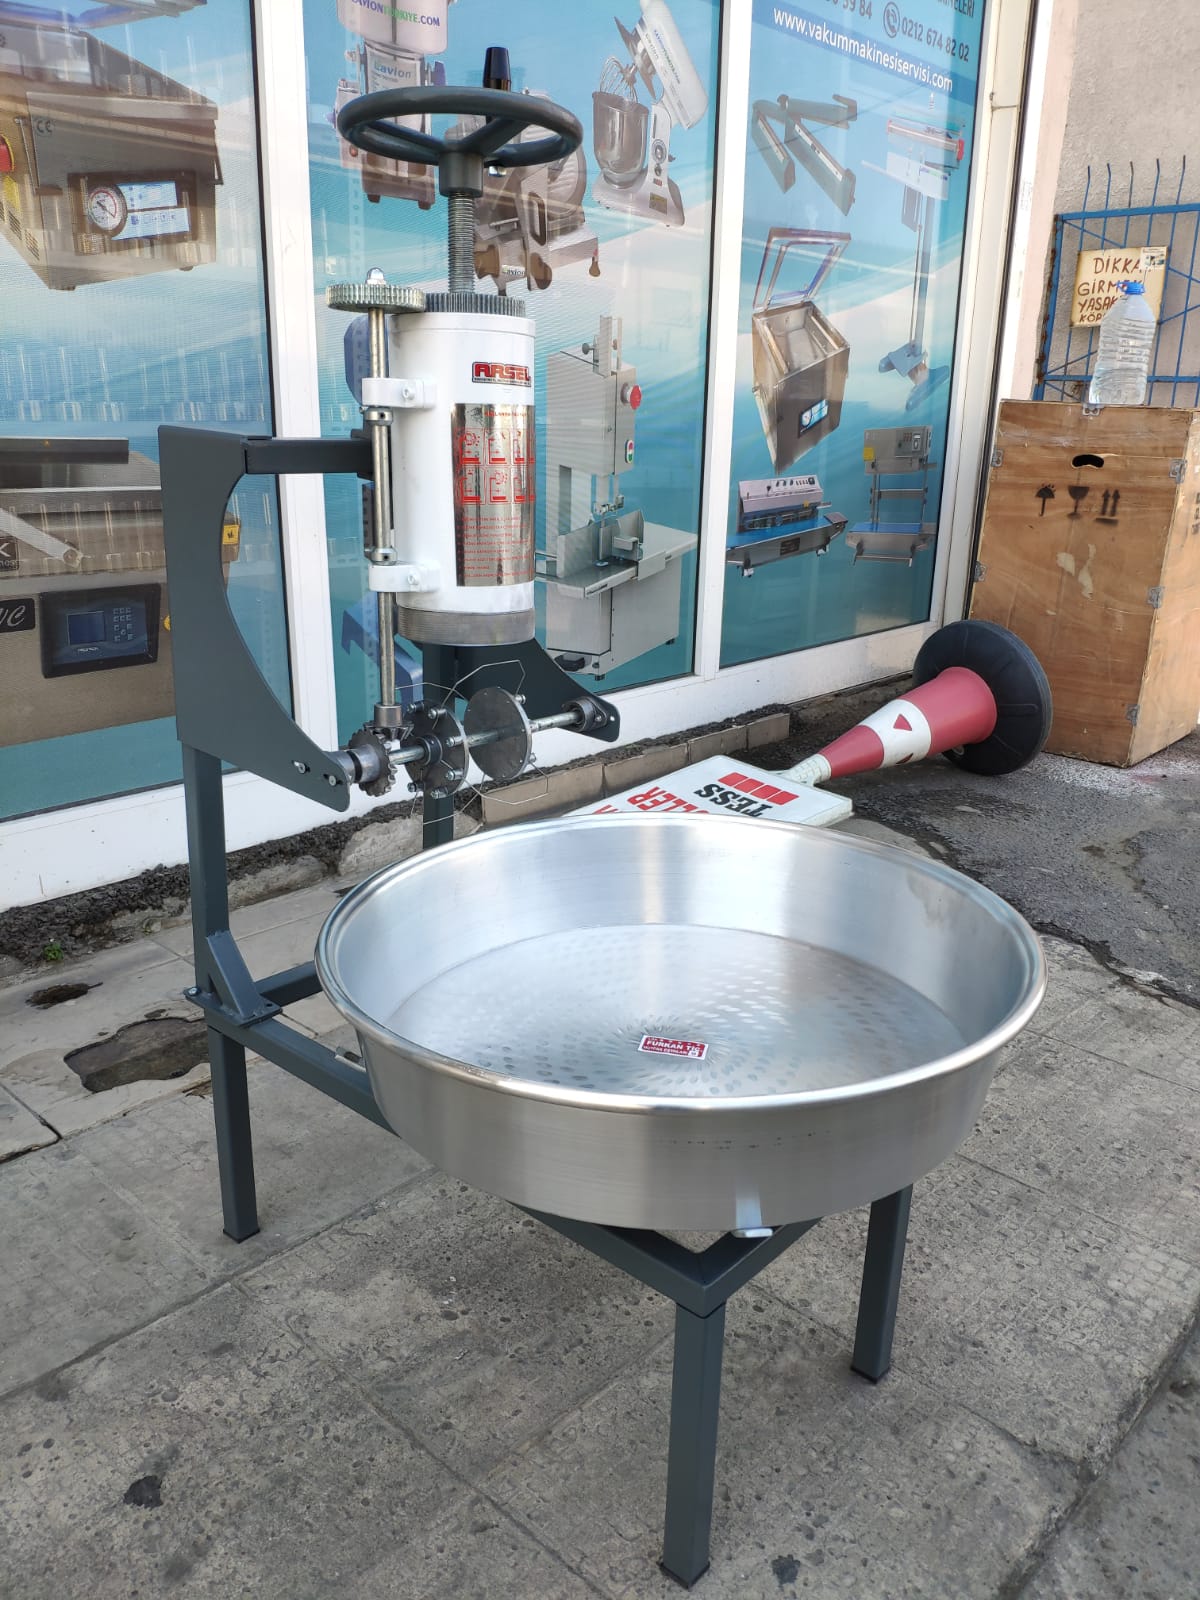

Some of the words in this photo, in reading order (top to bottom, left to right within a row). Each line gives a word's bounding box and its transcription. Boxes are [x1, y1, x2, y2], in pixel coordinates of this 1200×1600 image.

[859, 0, 873, 20] 84
[774, 7, 953, 92] www.vakummakinesiservisi.com
[902, 19, 923, 42] 0212
[926, 28, 943, 49] 674
[945, 37, 957, 57] 82
[958, 42, 970, 62] 02
[373, 60, 412, 79] Lavion
[1093, 256, 1147, 275] DİKKA
[474, 363, 530, 381] ARSEL
[694, 783, 773, 817] TESS
[646, 1040, 684, 1050] FURKAN
